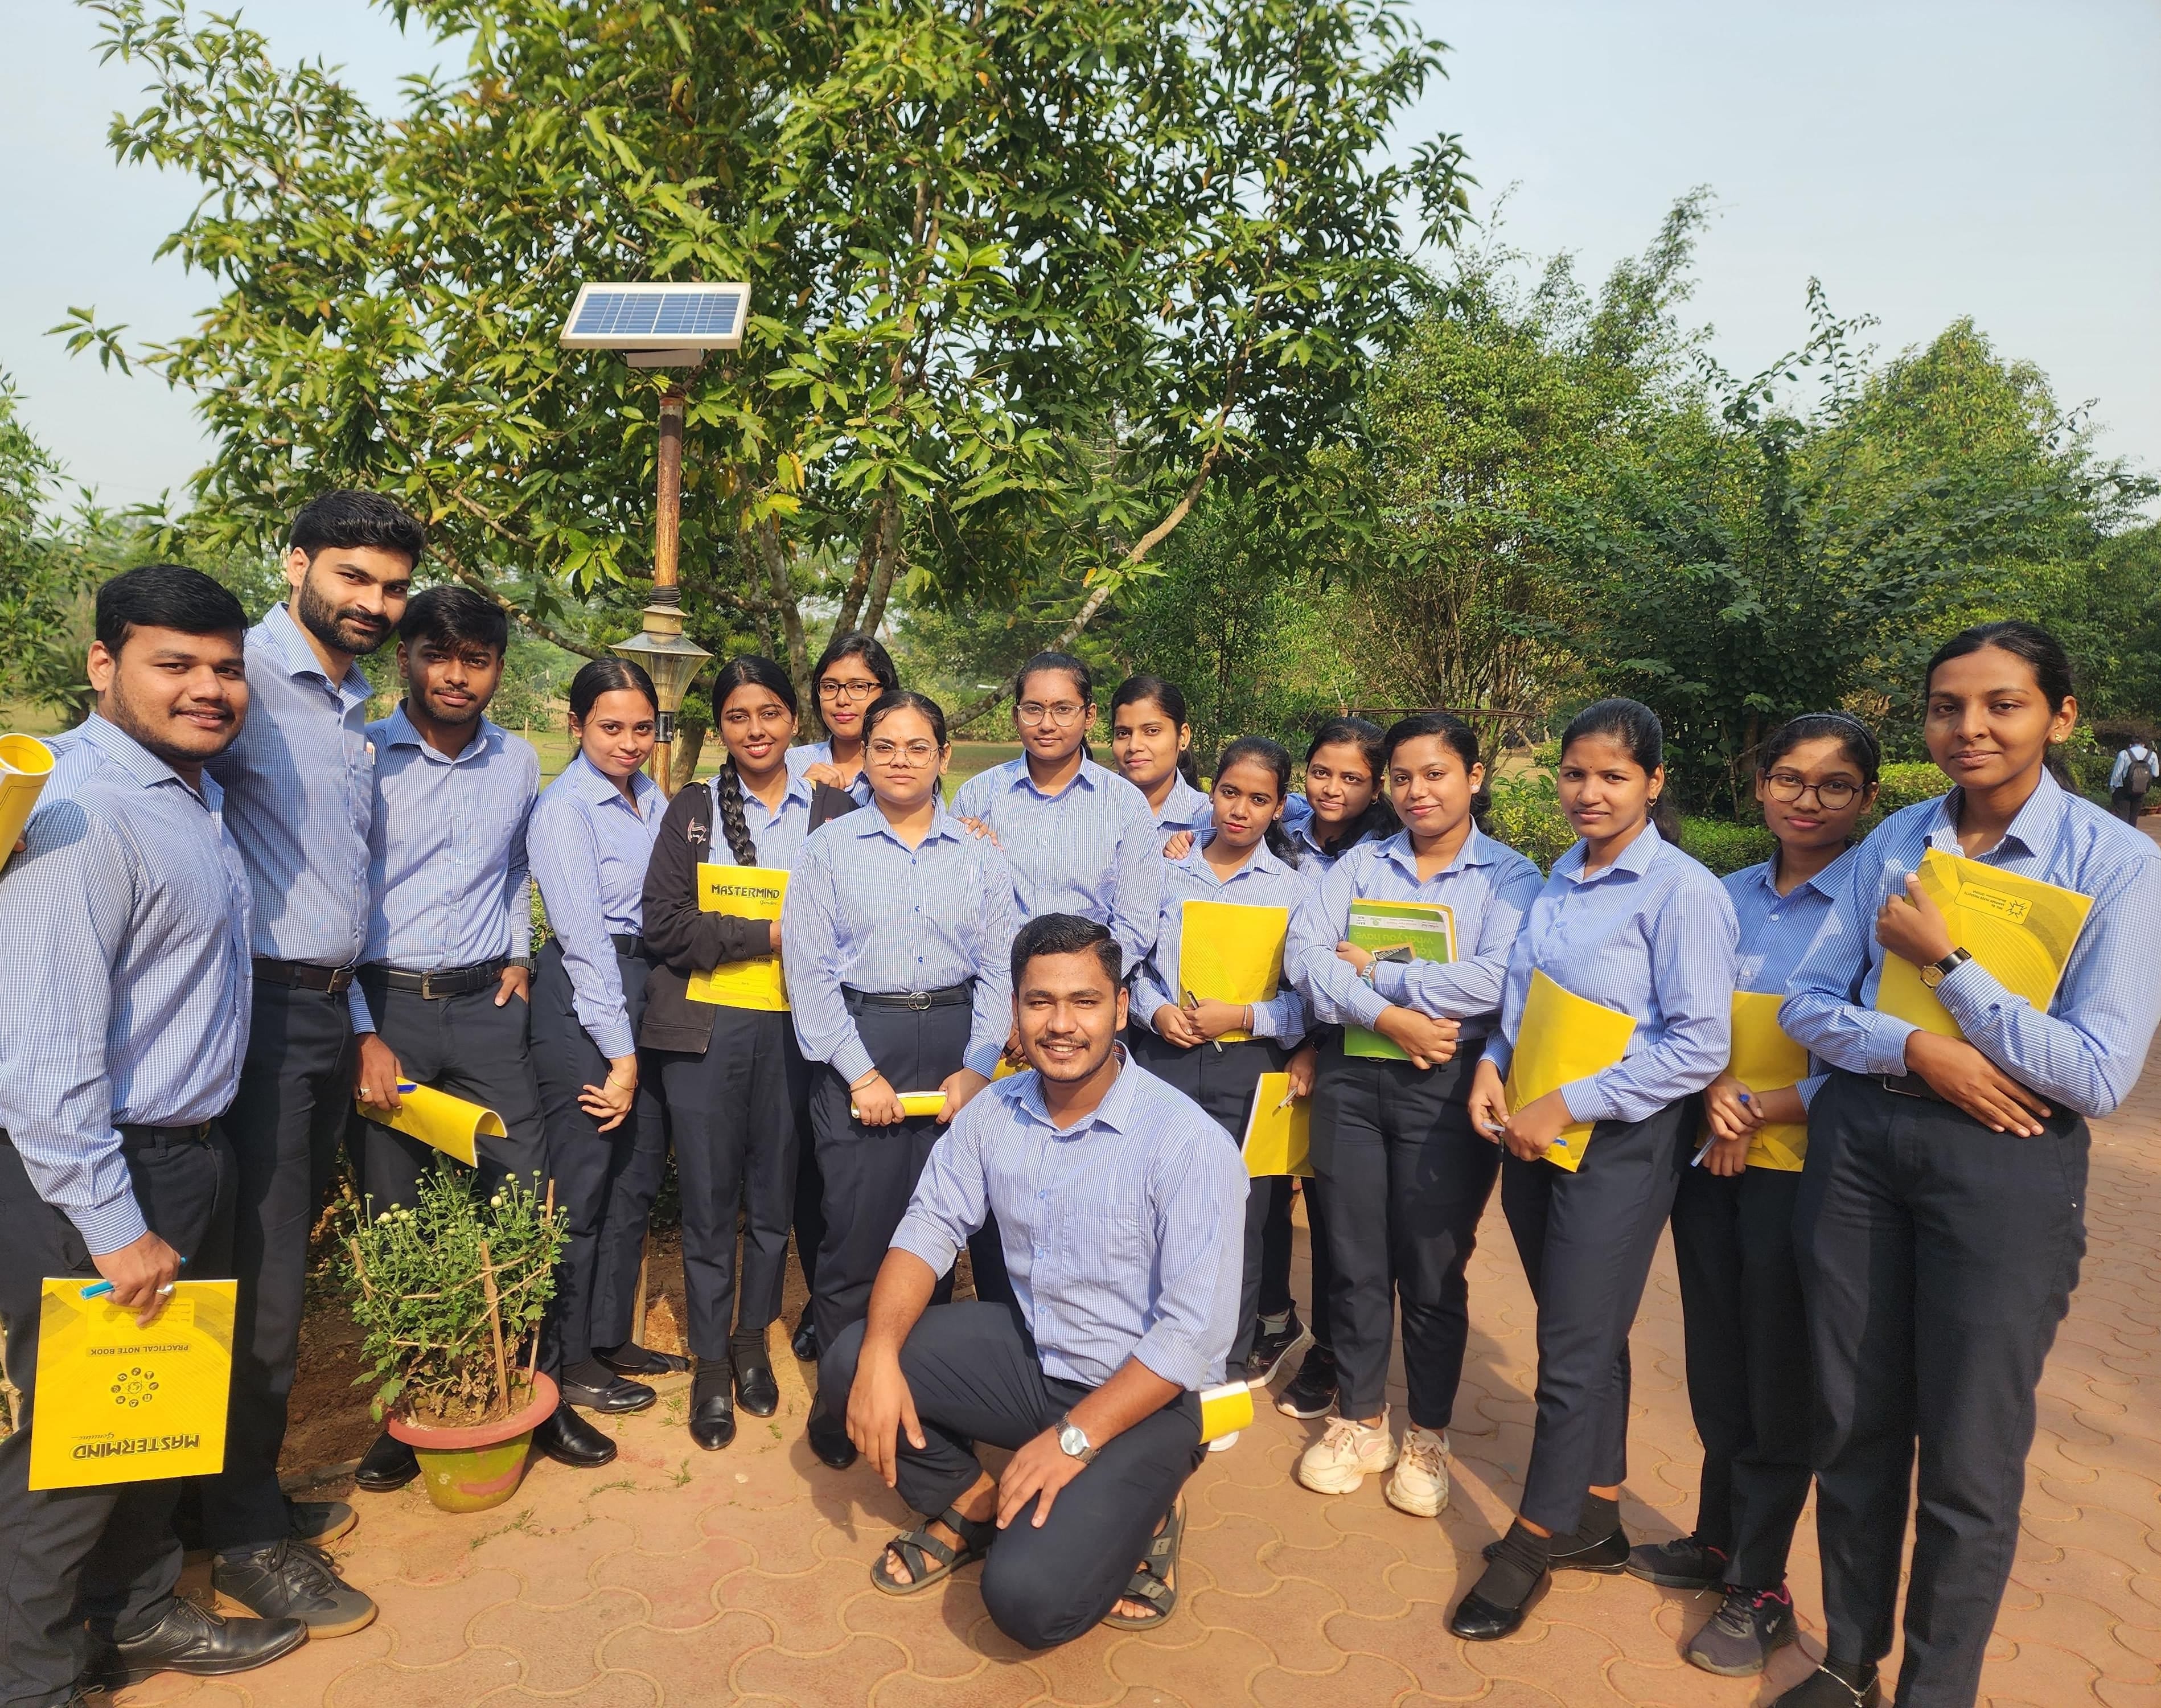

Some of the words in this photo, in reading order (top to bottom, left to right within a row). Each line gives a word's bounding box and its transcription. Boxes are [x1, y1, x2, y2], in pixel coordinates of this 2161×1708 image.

[711, 884, 780, 899] MASTERMIND
[1353, 932, 1381, 945] have.
[1383, 933, 1404, 943] you
[1404, 935, 1434, 947] what
[71, 1434, 200, 1460] MASTERMIND
